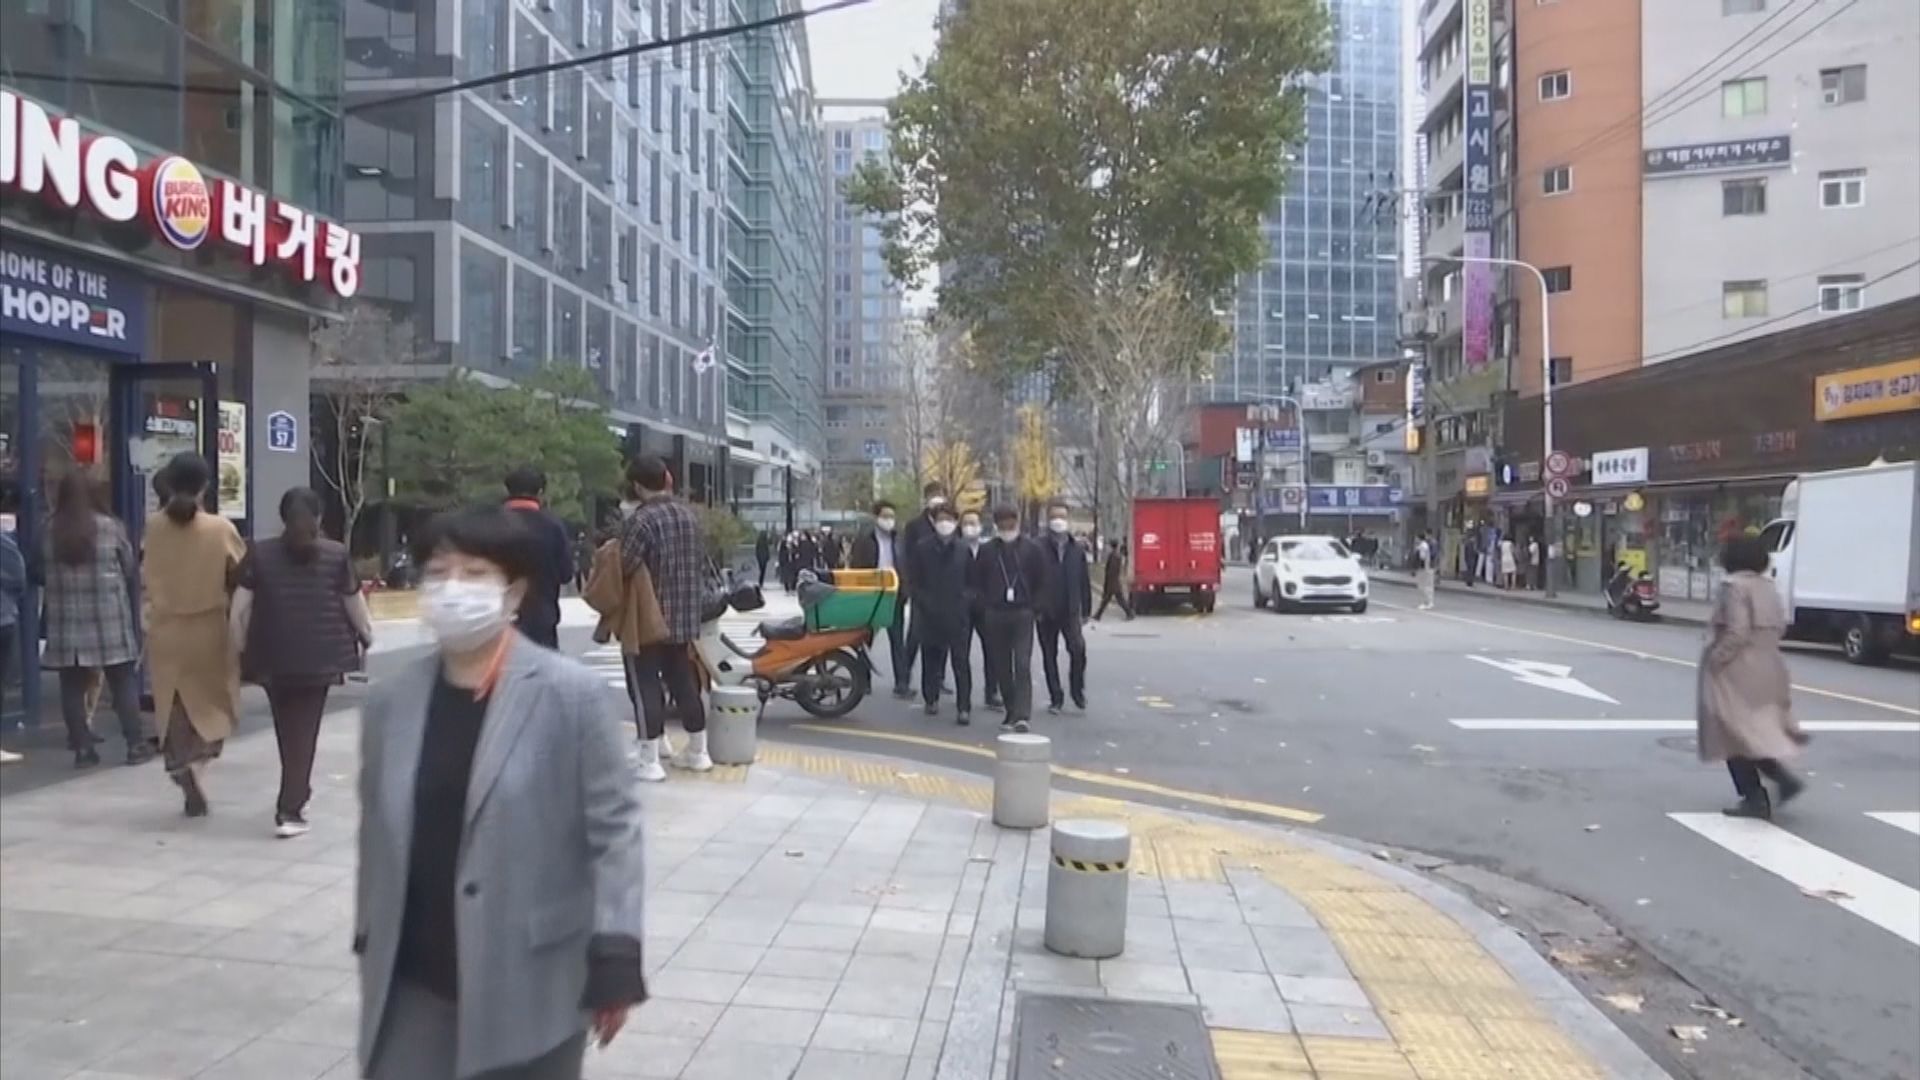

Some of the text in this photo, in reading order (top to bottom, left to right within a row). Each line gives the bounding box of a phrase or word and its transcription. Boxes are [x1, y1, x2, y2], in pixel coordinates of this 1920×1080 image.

[1470, 90, 1489, 194] 고시원
[165, 180, 205, 196] BURGER
[165, 195, 208, 219] KING
[222, 180, 361, 297] 버거킹
[52, 263, 74, 291] OF
[77, 270, 107, 299] THE
[0, 284, 126, 340] HOPPER
[276, 431, 289, 446] 57
